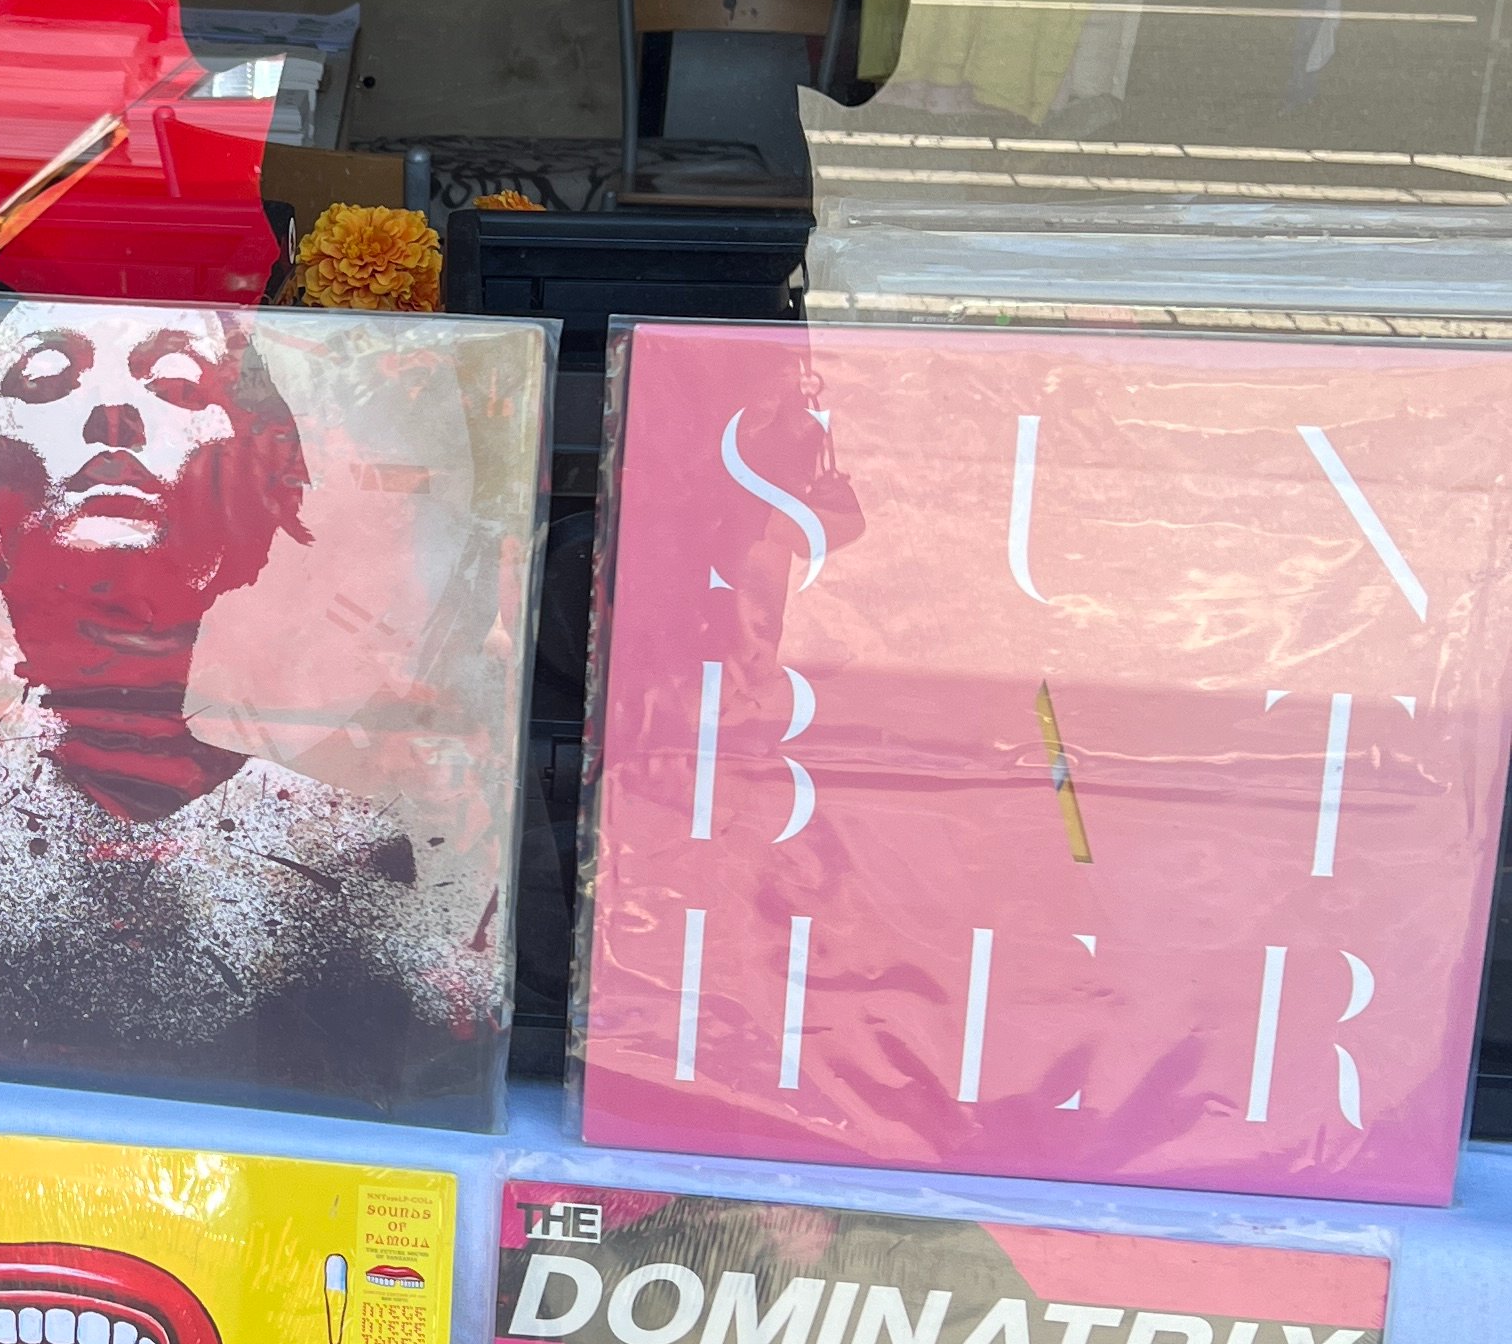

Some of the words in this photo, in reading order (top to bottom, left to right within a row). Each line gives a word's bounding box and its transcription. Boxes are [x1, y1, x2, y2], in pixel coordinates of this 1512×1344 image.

[367, 1204, 431, 1219] SOUNDS
[388, 1221, 407, 1232] OF
[515, 1201, 600, 1241] THE
